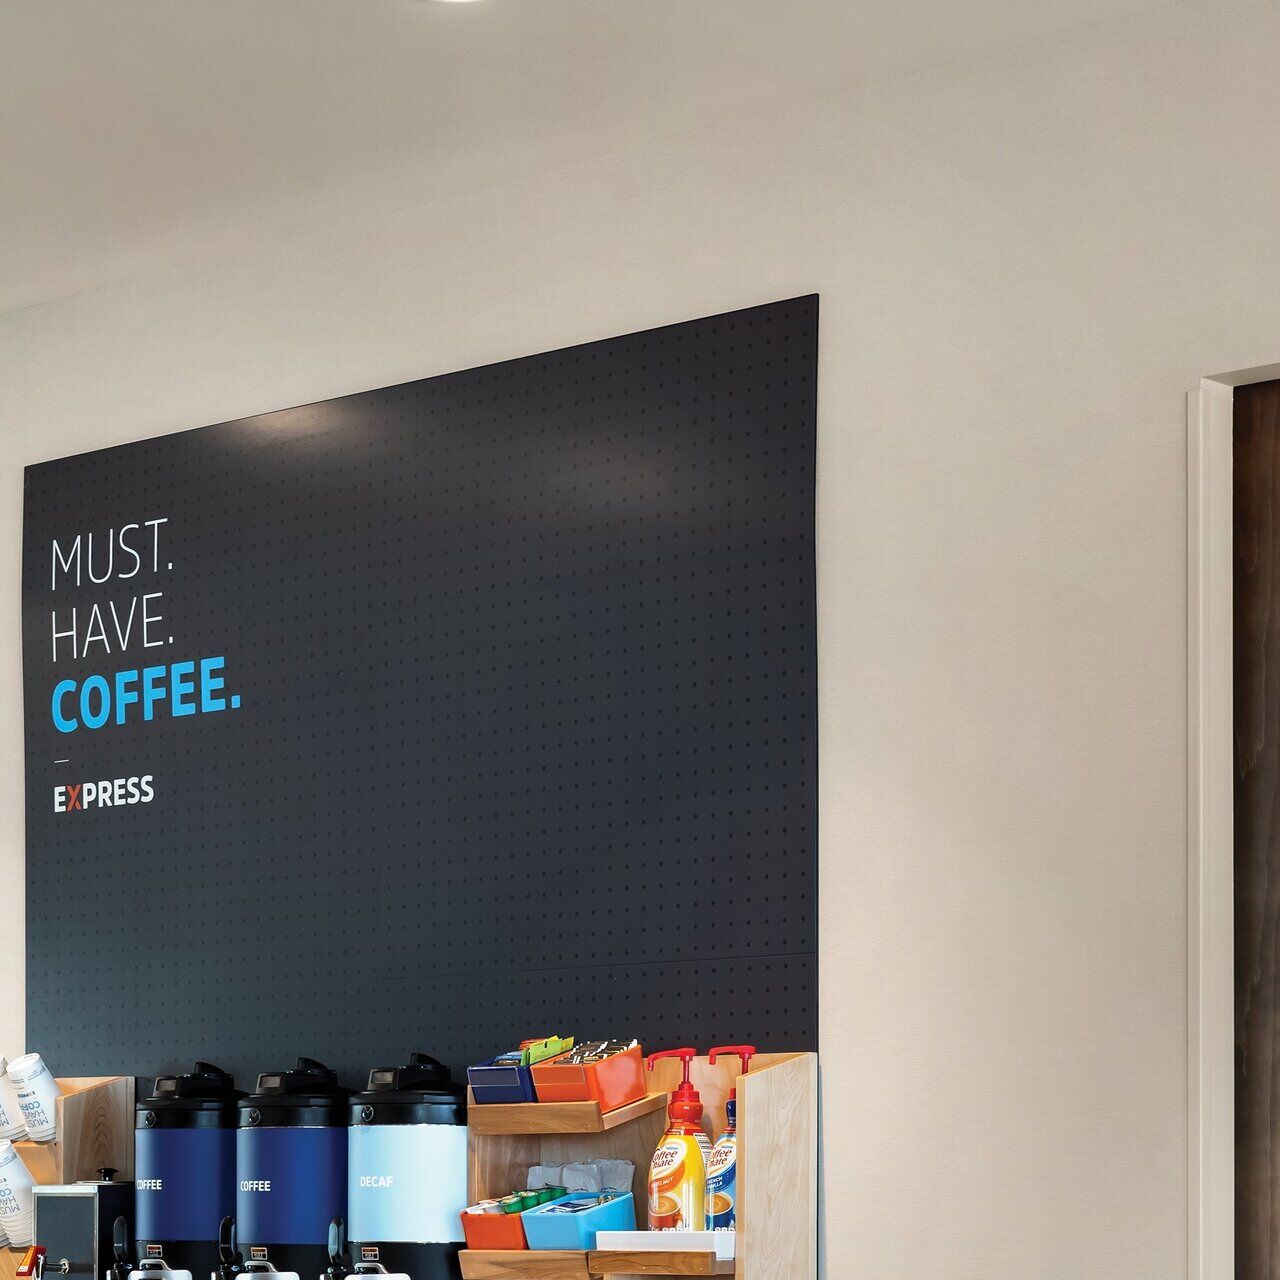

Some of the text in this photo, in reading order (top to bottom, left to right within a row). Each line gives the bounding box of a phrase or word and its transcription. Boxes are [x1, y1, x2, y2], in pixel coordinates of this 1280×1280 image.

[52, 517, 173, 591] MUST.
[52, 592, 174, 663] HAVE.
[51, 656, 241, 733] COFFEE.
[53, 774, 155, 813] EXPRESS
[136, 1179, 163, 1190] COFFEE
[240, 1180, 271, 1192] COFFEE
[360, 1175, 394, 1187] DECAF
